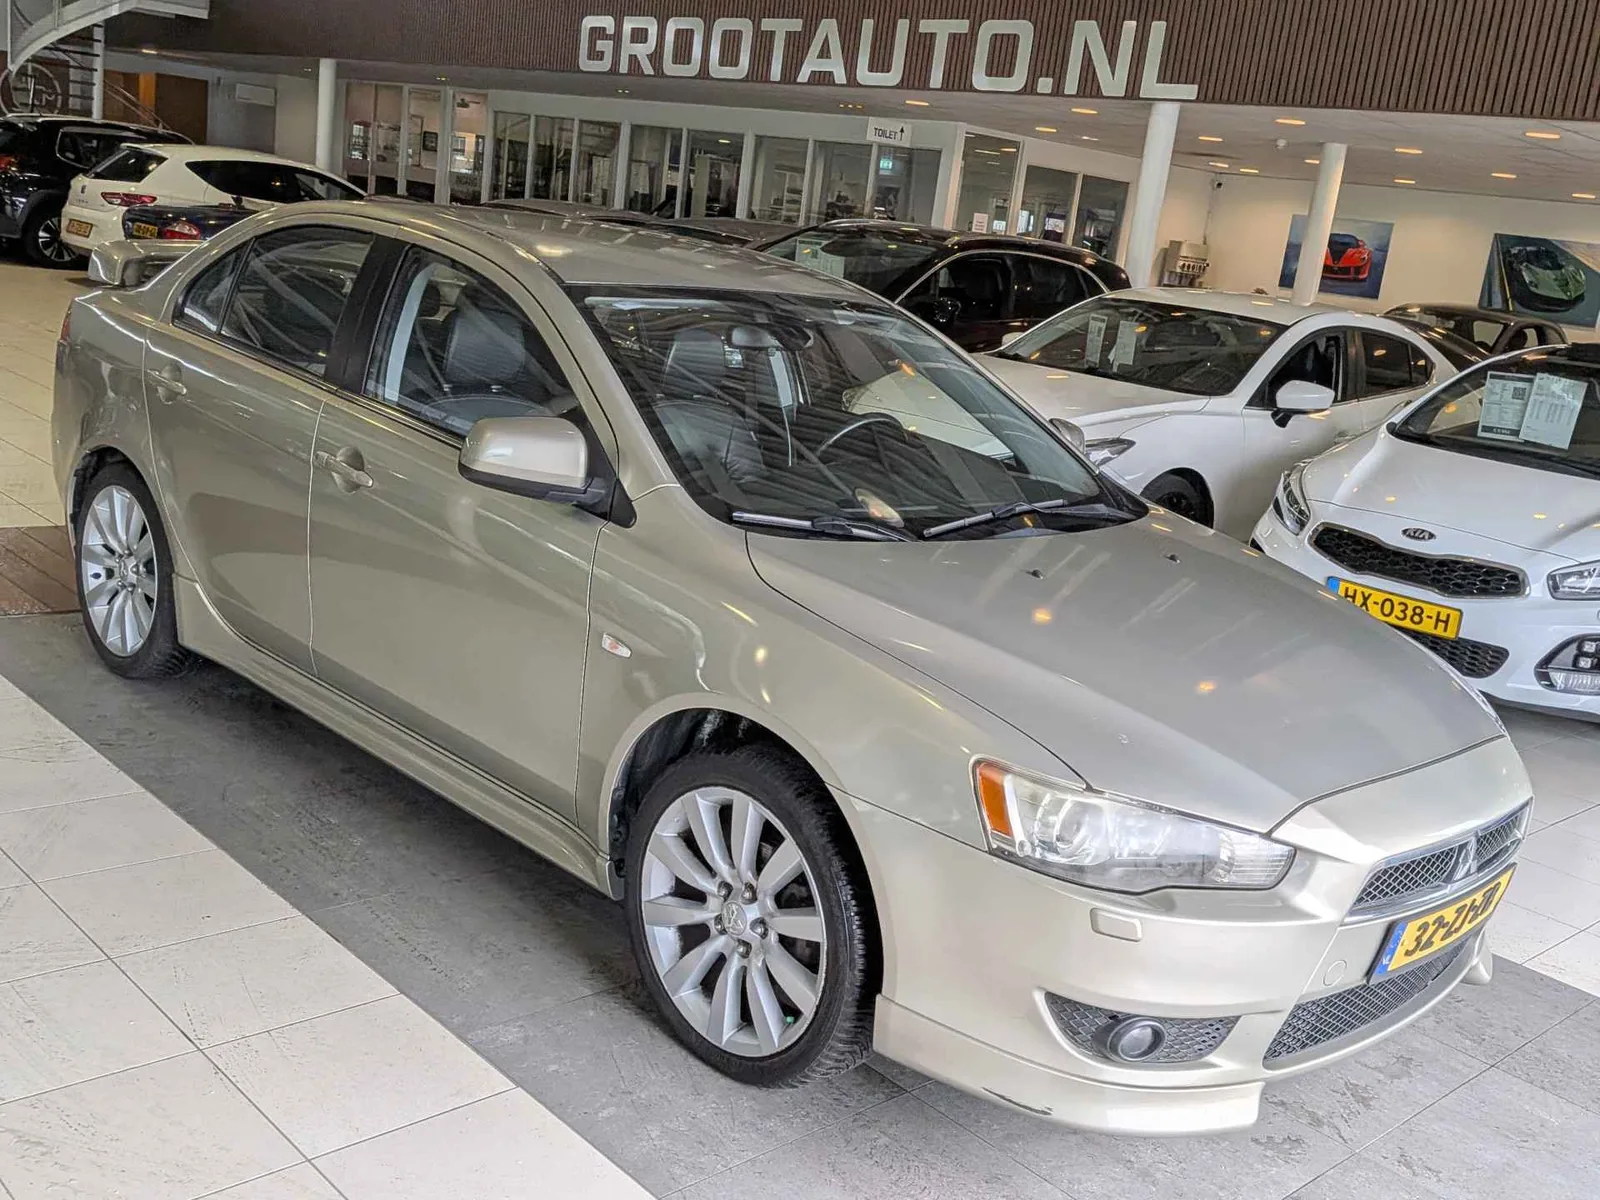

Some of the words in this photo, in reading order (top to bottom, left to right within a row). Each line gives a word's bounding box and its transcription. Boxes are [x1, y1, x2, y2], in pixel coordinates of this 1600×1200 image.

[579, 15, 1199, 100] GROOTAUTO.NL
[873, 127, 898, 140] TOILET
[1406, 529, 1430, 540] KIA
[1344, 586, 1451, 633] HX-038-H
